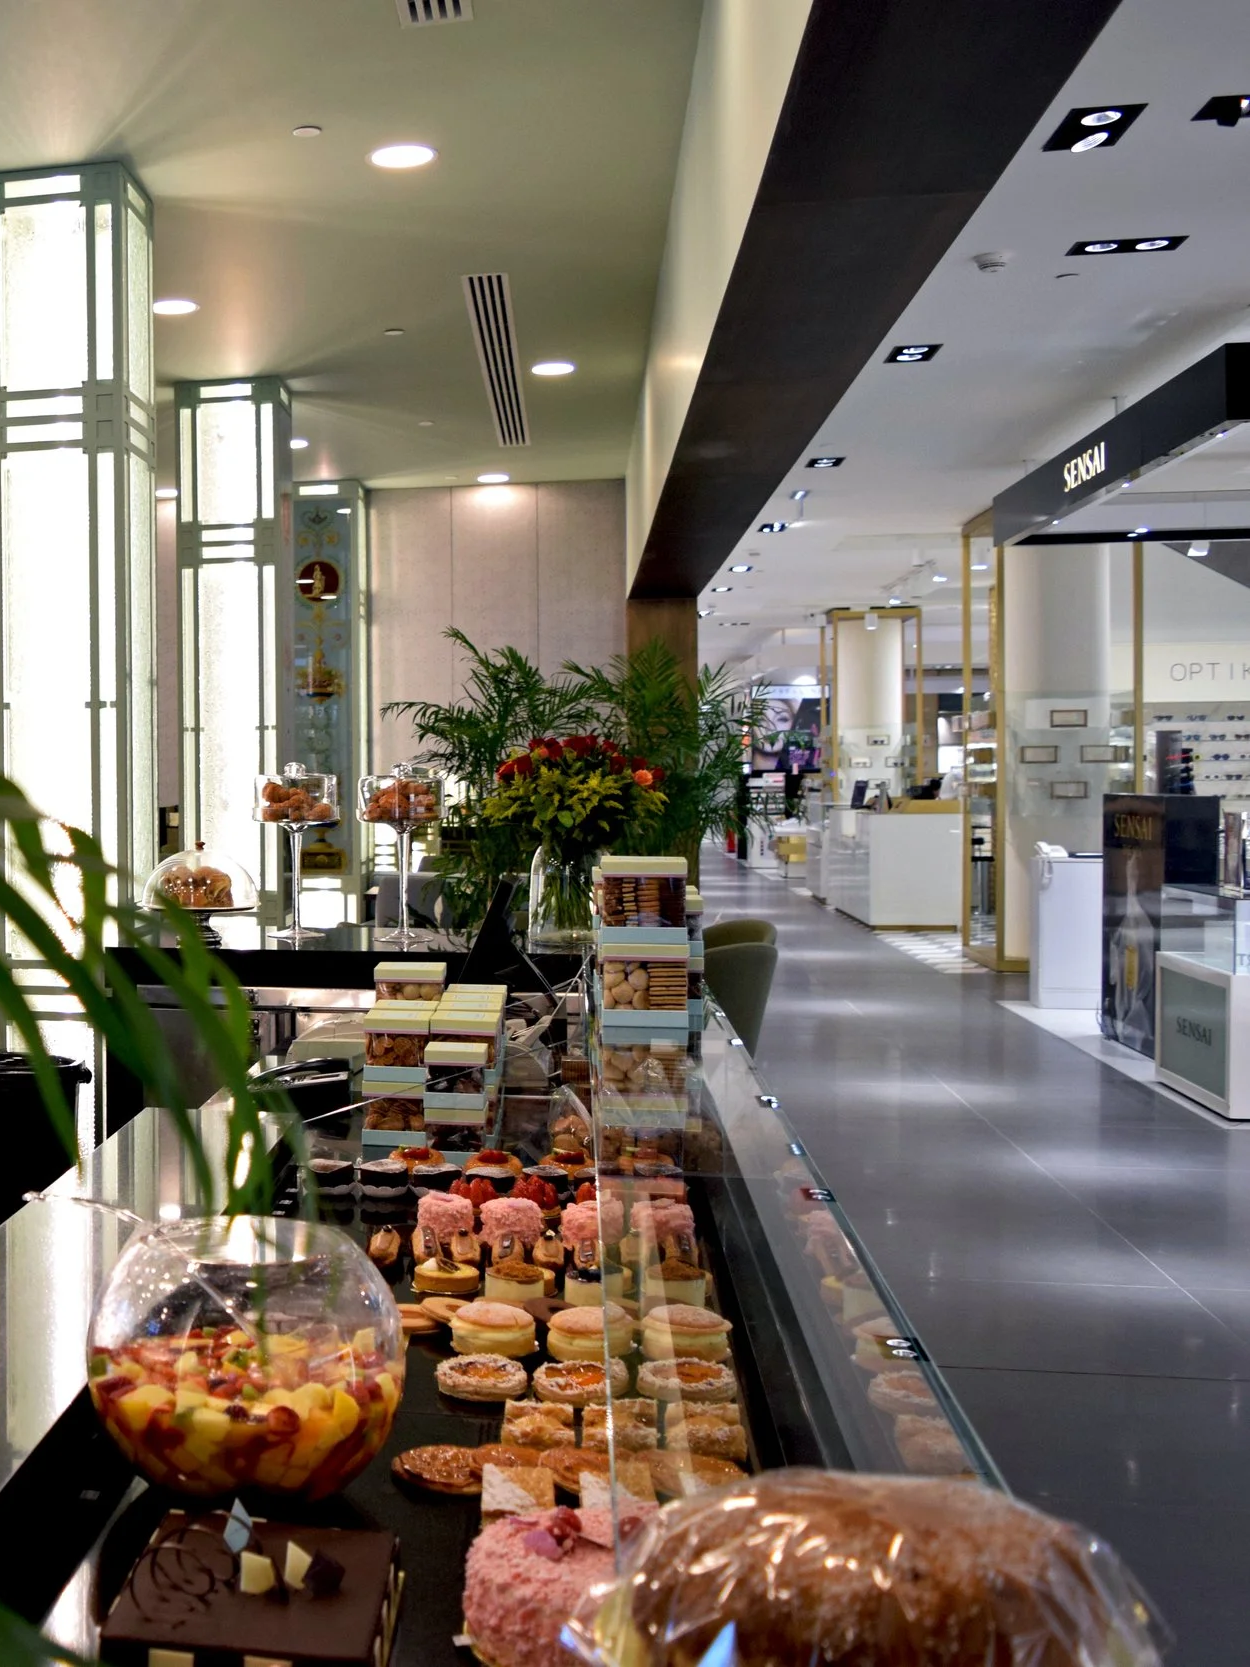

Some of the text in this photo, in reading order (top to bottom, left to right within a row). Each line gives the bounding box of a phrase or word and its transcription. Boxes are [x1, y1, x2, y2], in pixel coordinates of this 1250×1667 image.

[1063, 441, 1105, 492] SENSAI
[1114, 813, 1152, 841] SENSAI
[1176, 1016, 1212, 1047] SENSAI
